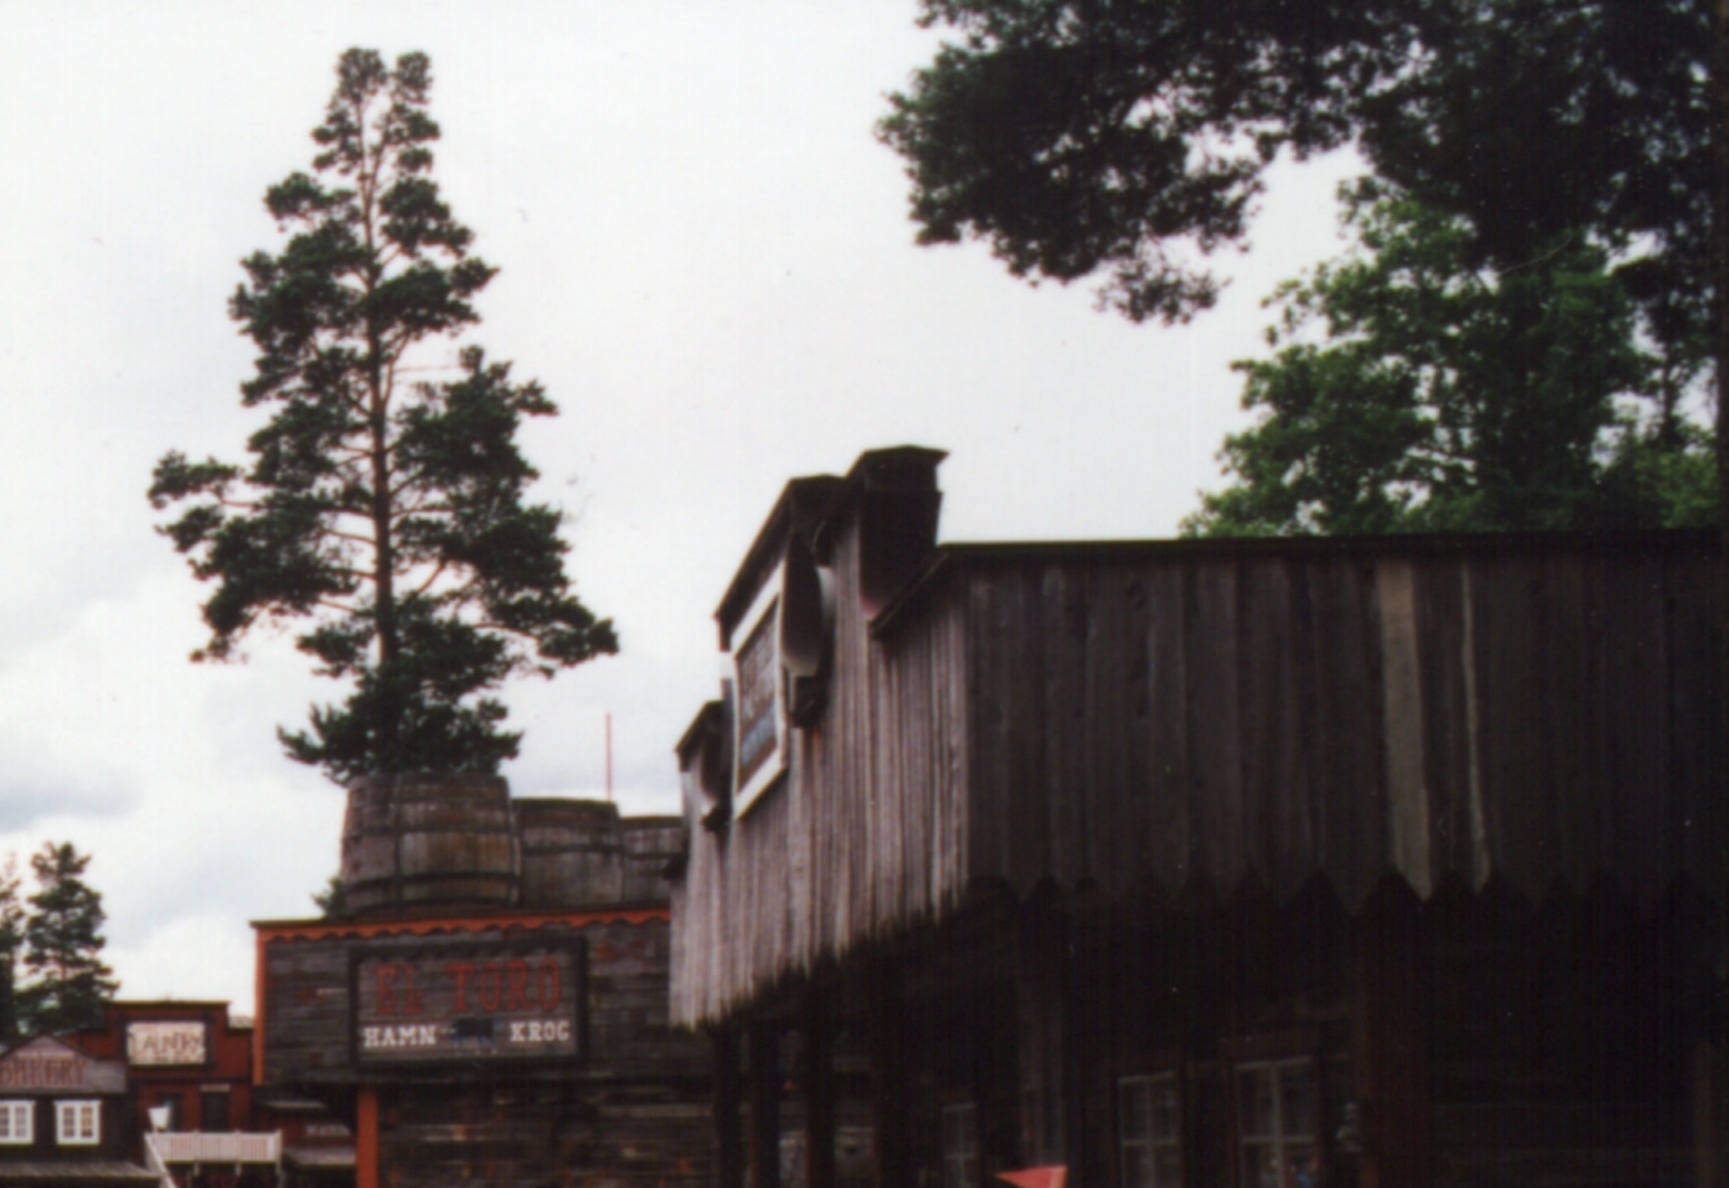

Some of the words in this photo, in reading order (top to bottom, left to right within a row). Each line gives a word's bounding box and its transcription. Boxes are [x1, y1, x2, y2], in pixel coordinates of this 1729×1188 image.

[376, 966, 424, 1015] EL
[447, 960, 560, 1013] TORO
[364, 1026, 437, 1047] HAMN
[510, 1021, 570, 1042] KROG
[0, 1059, 88, 1085] BAKERY
